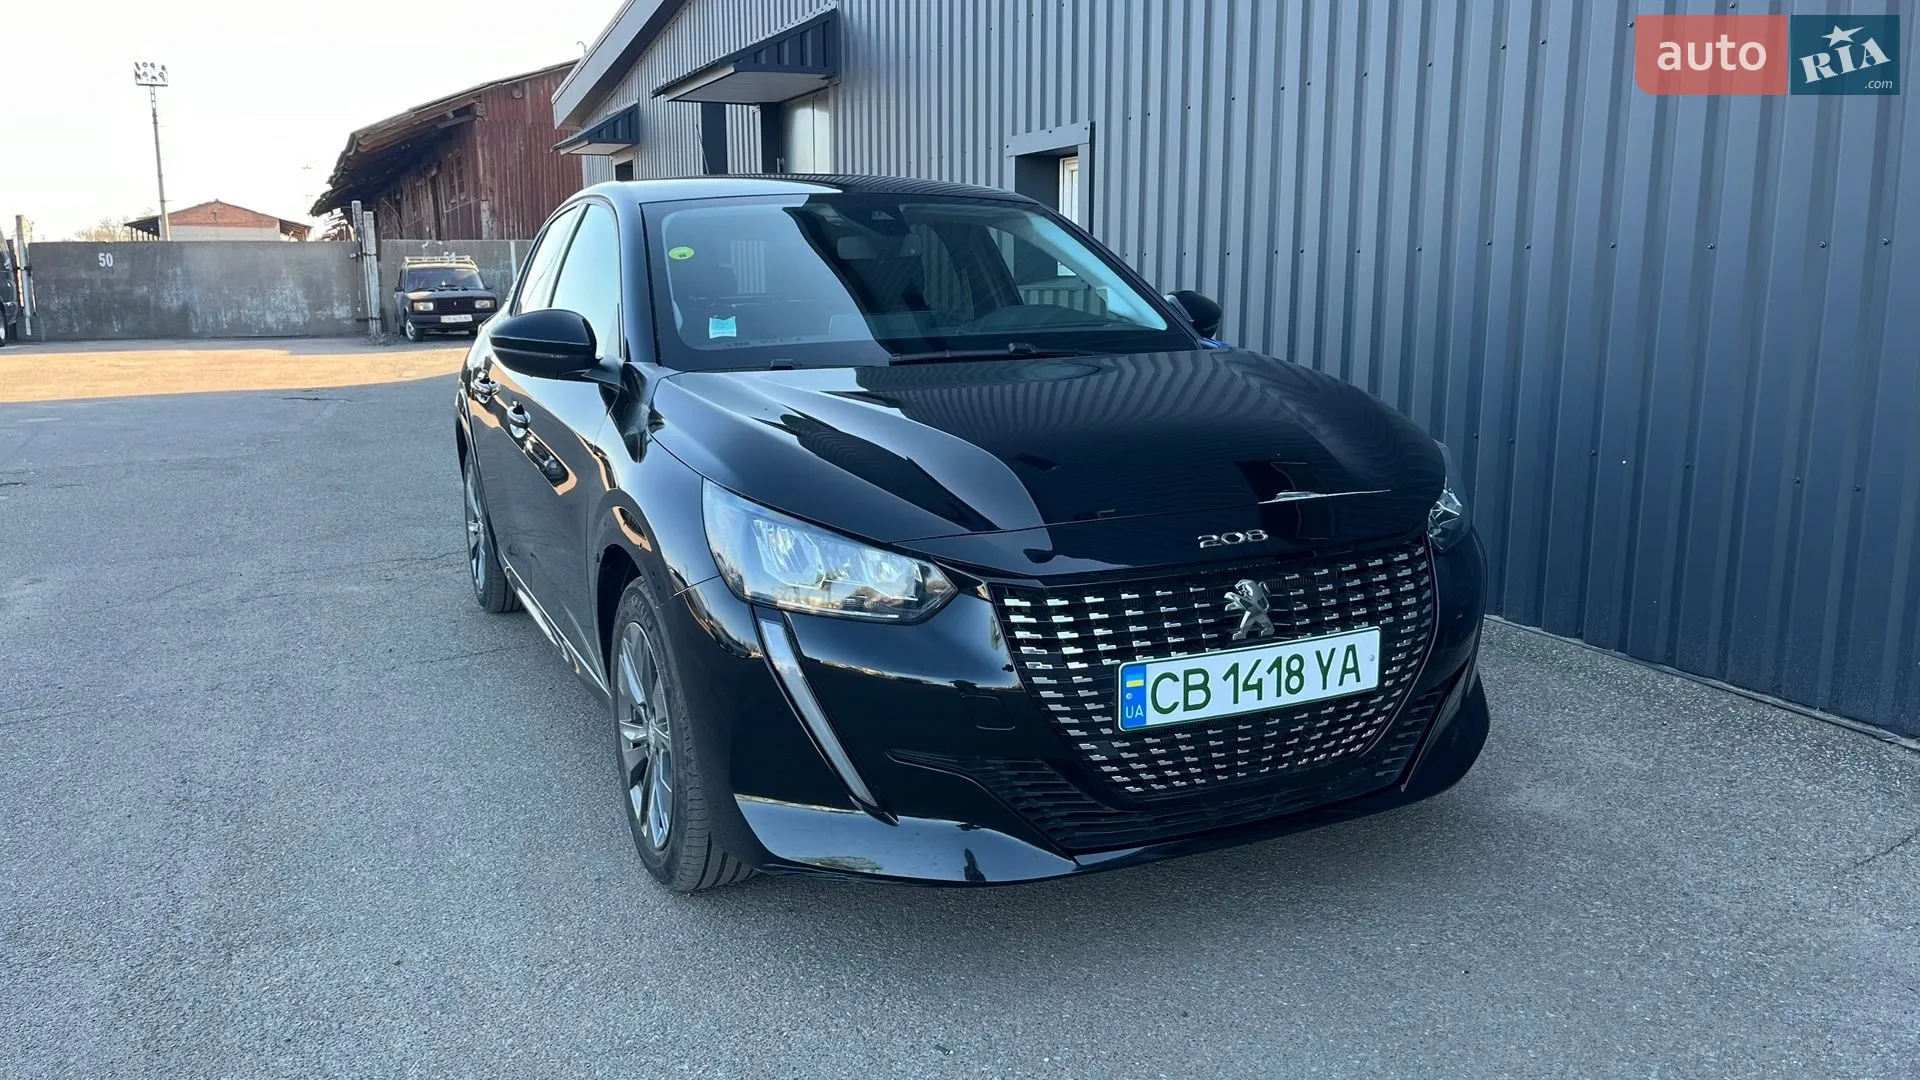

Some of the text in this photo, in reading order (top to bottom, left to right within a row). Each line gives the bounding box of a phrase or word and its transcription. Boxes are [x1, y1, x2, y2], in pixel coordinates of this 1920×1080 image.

[98, 252, 114, 267] 50
[1197, 529, 1269, 549] 208
[1150, 643, 1362, 715] CB 1418 YA
[1125, 704, 1145, 719] UA
